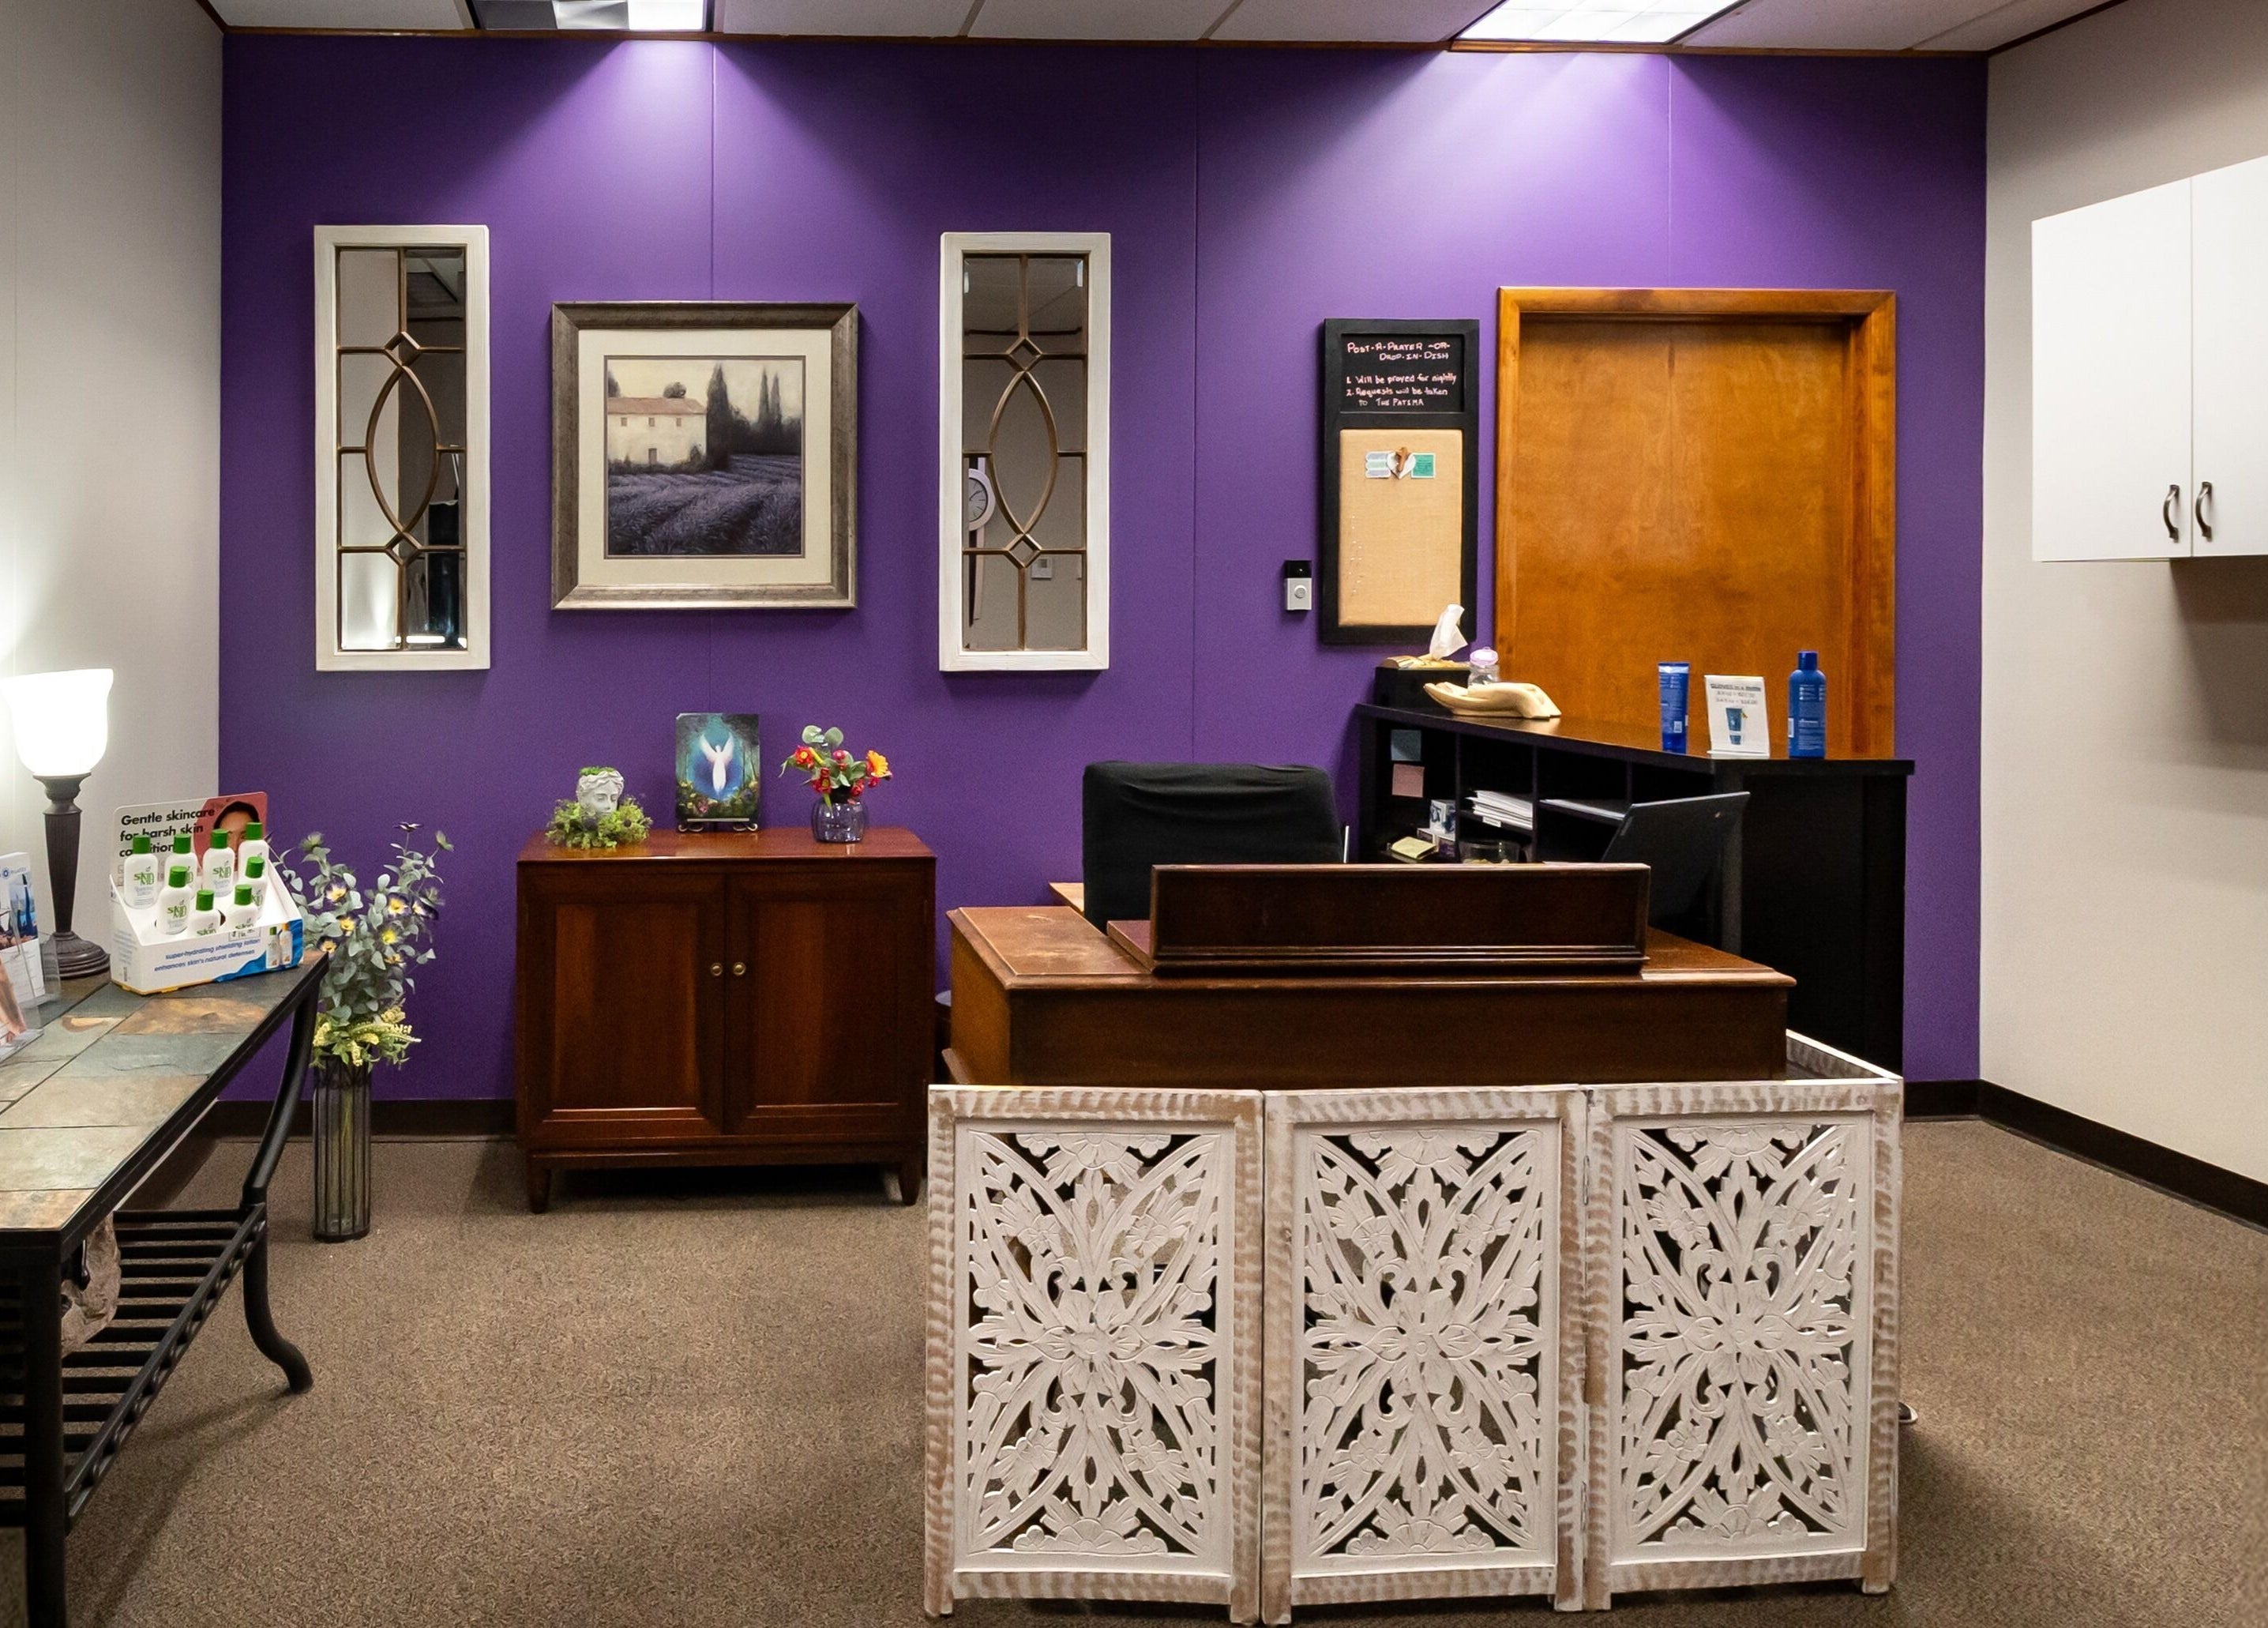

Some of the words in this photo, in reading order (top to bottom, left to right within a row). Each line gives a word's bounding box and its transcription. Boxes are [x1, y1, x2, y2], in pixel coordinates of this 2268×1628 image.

[1375, 374, 1385, 384] be
[1417, 373, 1430, 382] for
[1412, 387, 1423, 396] be
[122, 812, 163, 825] Gentle
[166, 809, 215, 822] skincare
[180, 823, 204, 835] skin
